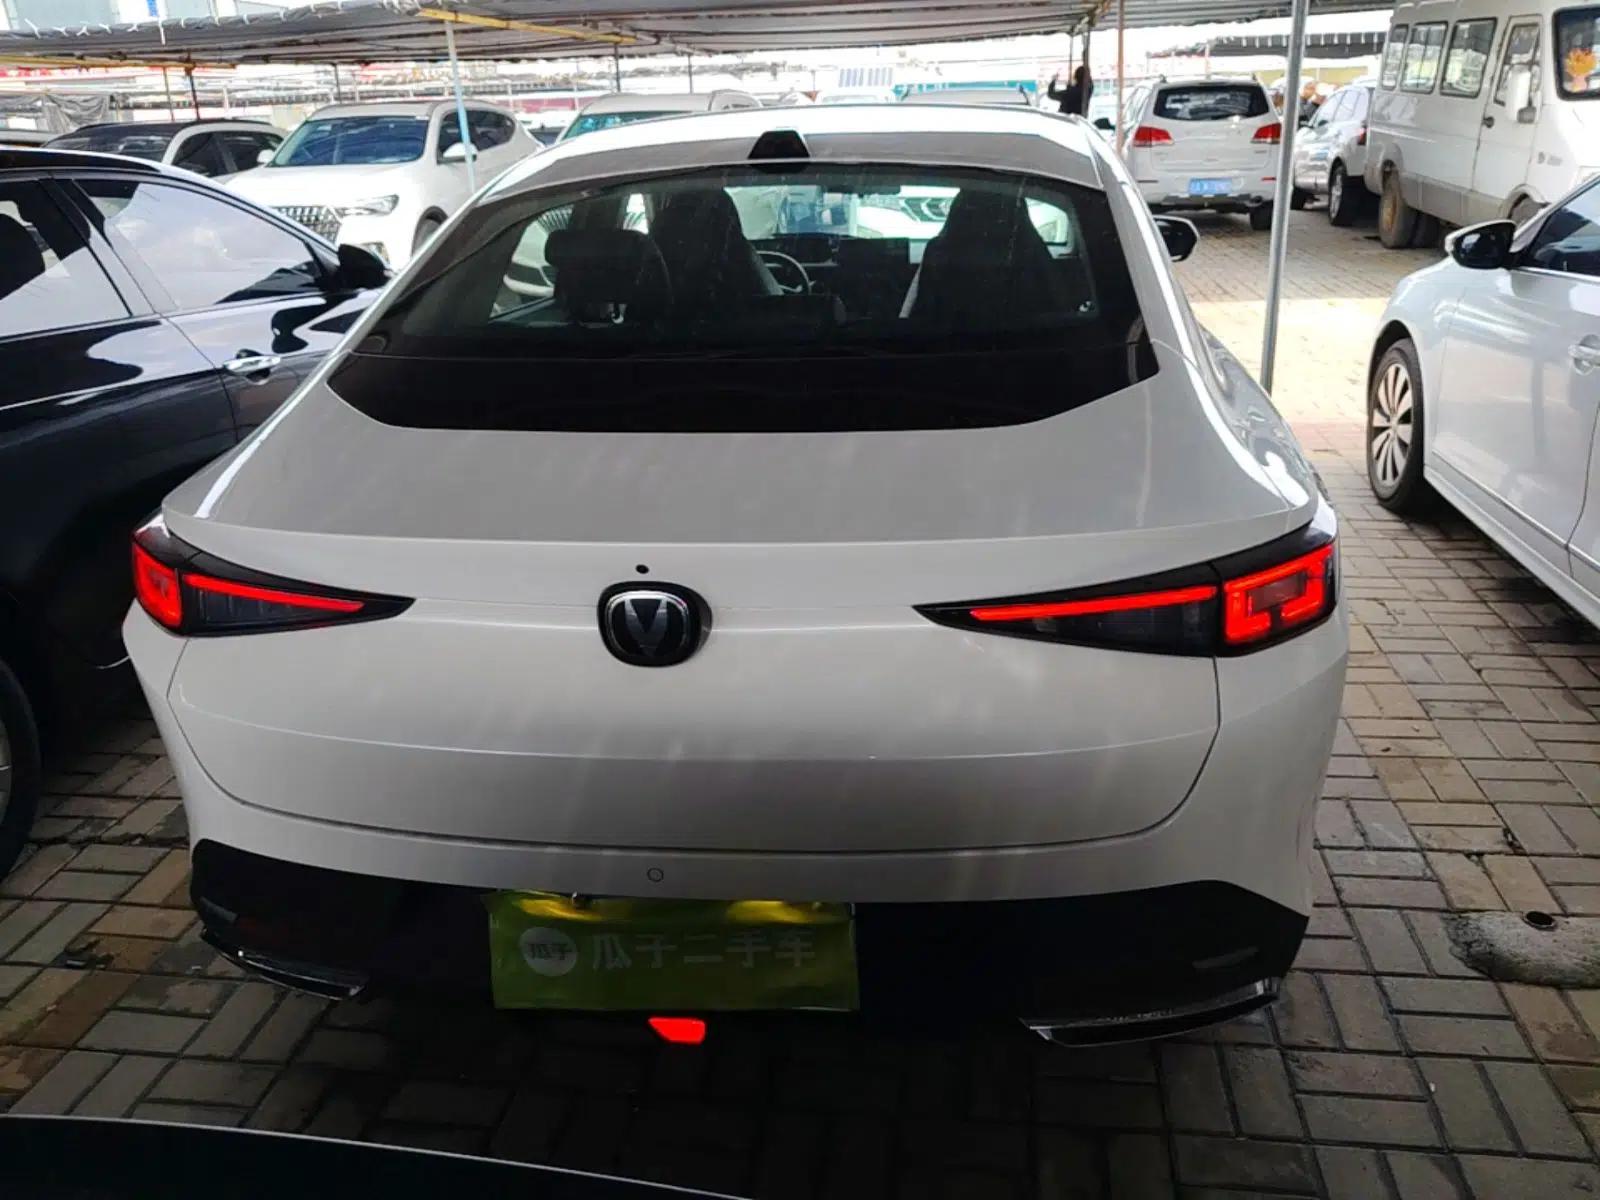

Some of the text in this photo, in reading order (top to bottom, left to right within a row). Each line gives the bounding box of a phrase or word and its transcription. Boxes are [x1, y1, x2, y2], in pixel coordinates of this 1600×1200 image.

[528, 942, 574, 961] 瓜子
[592, 929, 816, 969] 瓜子二手车
